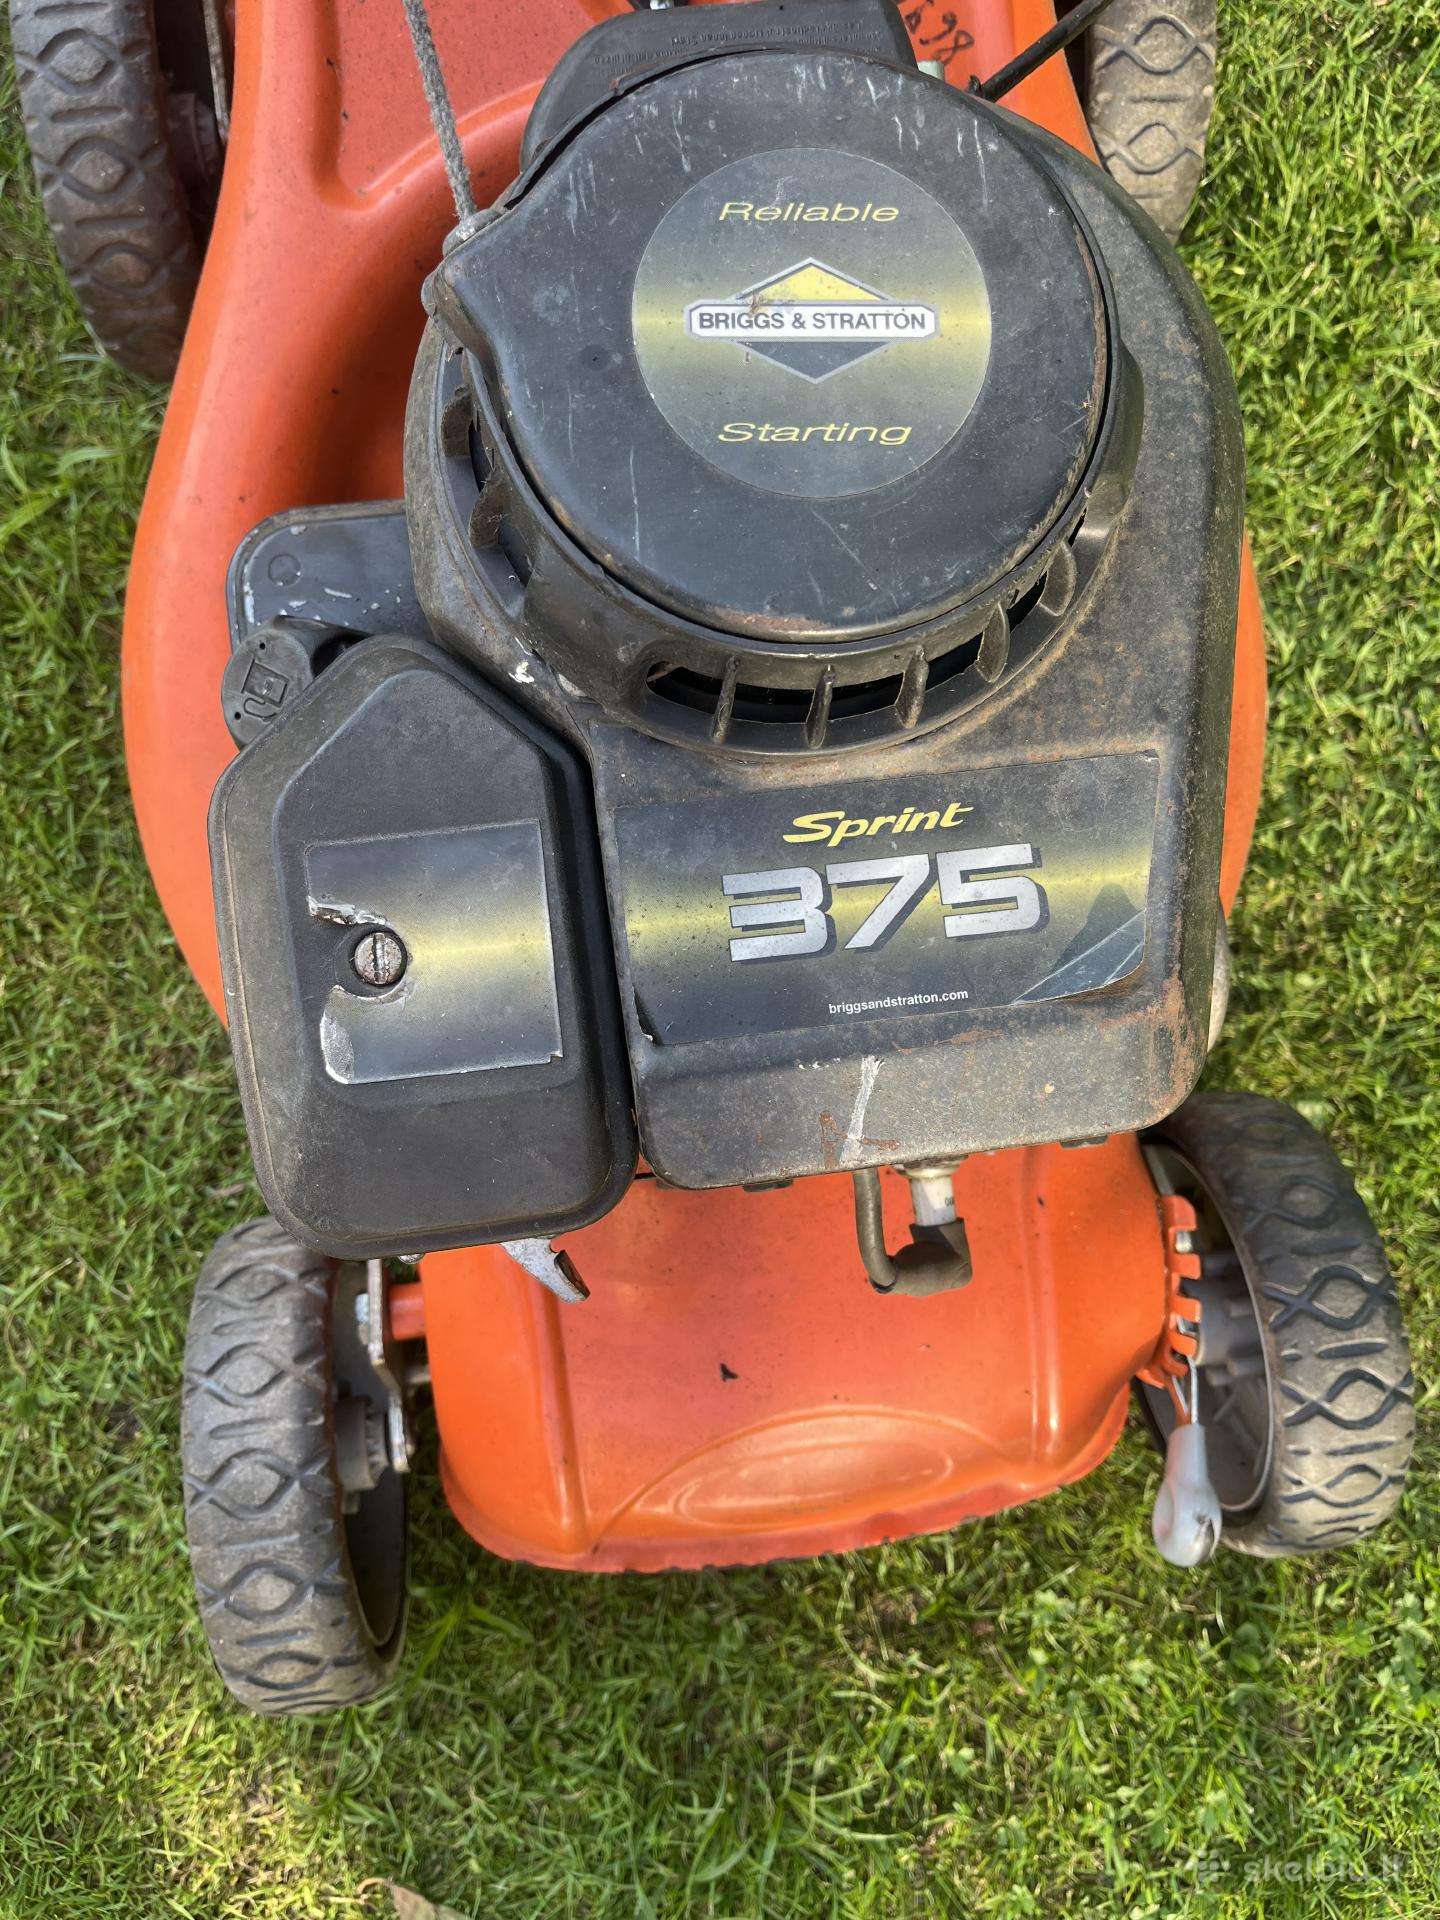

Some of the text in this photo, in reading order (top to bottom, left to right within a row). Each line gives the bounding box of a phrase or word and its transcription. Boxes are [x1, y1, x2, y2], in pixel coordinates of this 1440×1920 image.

[718, 202, 899, 222] Reliable
[699, 312, 926, 330] BRIGGS & STRATTON
[718, 422, 912, 445] Starting
[782, 802, 974, 847] Sprint
[721, 843, 1042, 963] 375
[828, 989, 969, 1015] briggsandstratton.com
